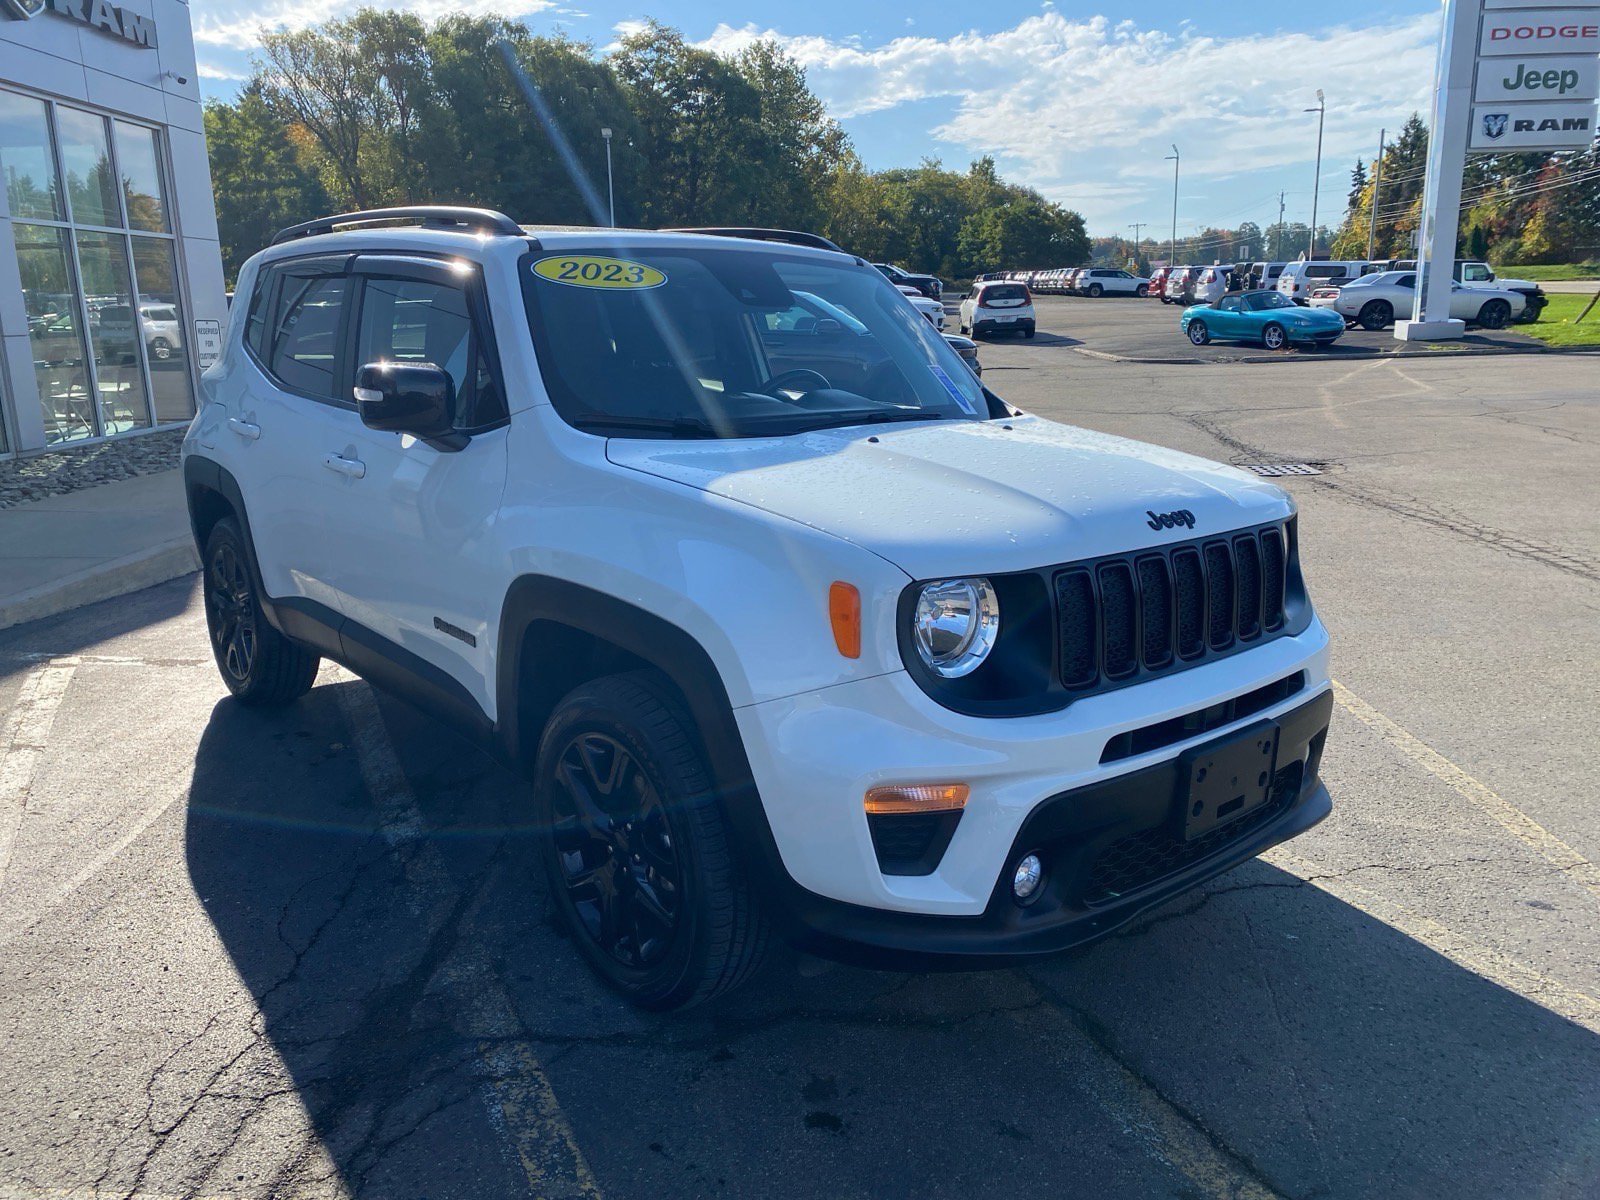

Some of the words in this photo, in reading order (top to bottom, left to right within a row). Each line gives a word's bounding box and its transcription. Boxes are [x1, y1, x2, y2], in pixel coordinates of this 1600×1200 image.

[1491, 26, 1599, 40] DODGE
[1503, 64, 1578, 94] Jeep
[1514, 118, 1589, 132] RAM
[558, 261, 645, 283] 2023
[197, 327, 218, 335] RESERVED
[1146, 509, 1196, 531] Jeep
